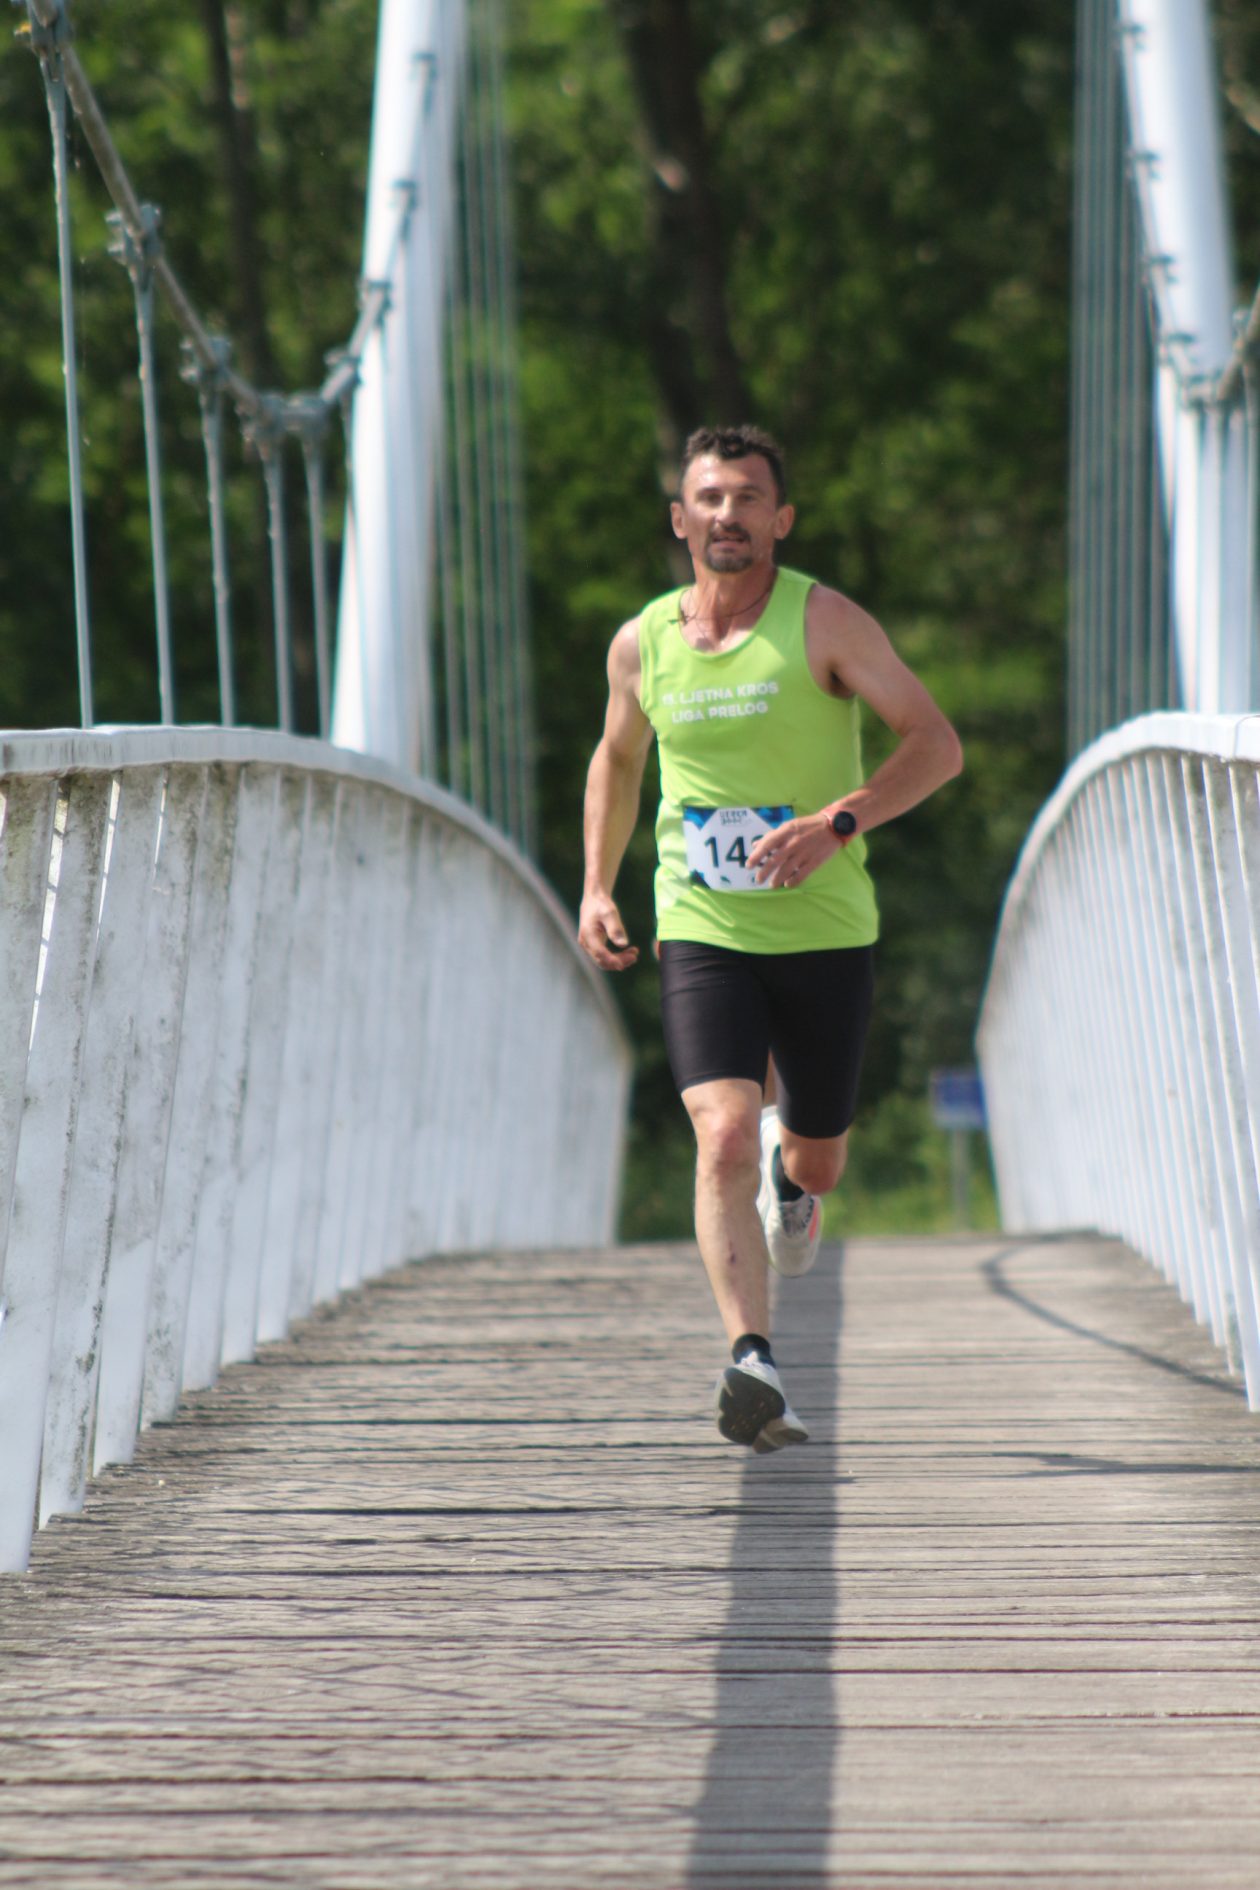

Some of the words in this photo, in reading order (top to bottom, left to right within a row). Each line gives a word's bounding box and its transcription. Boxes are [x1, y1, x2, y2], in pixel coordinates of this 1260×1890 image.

[679, 687, 733, 704] LJETNA
[736, 682, 779, 697] KROS
[672, 709, 705, 724] LIGA
[708, 701, 768, 719] PRELOG
